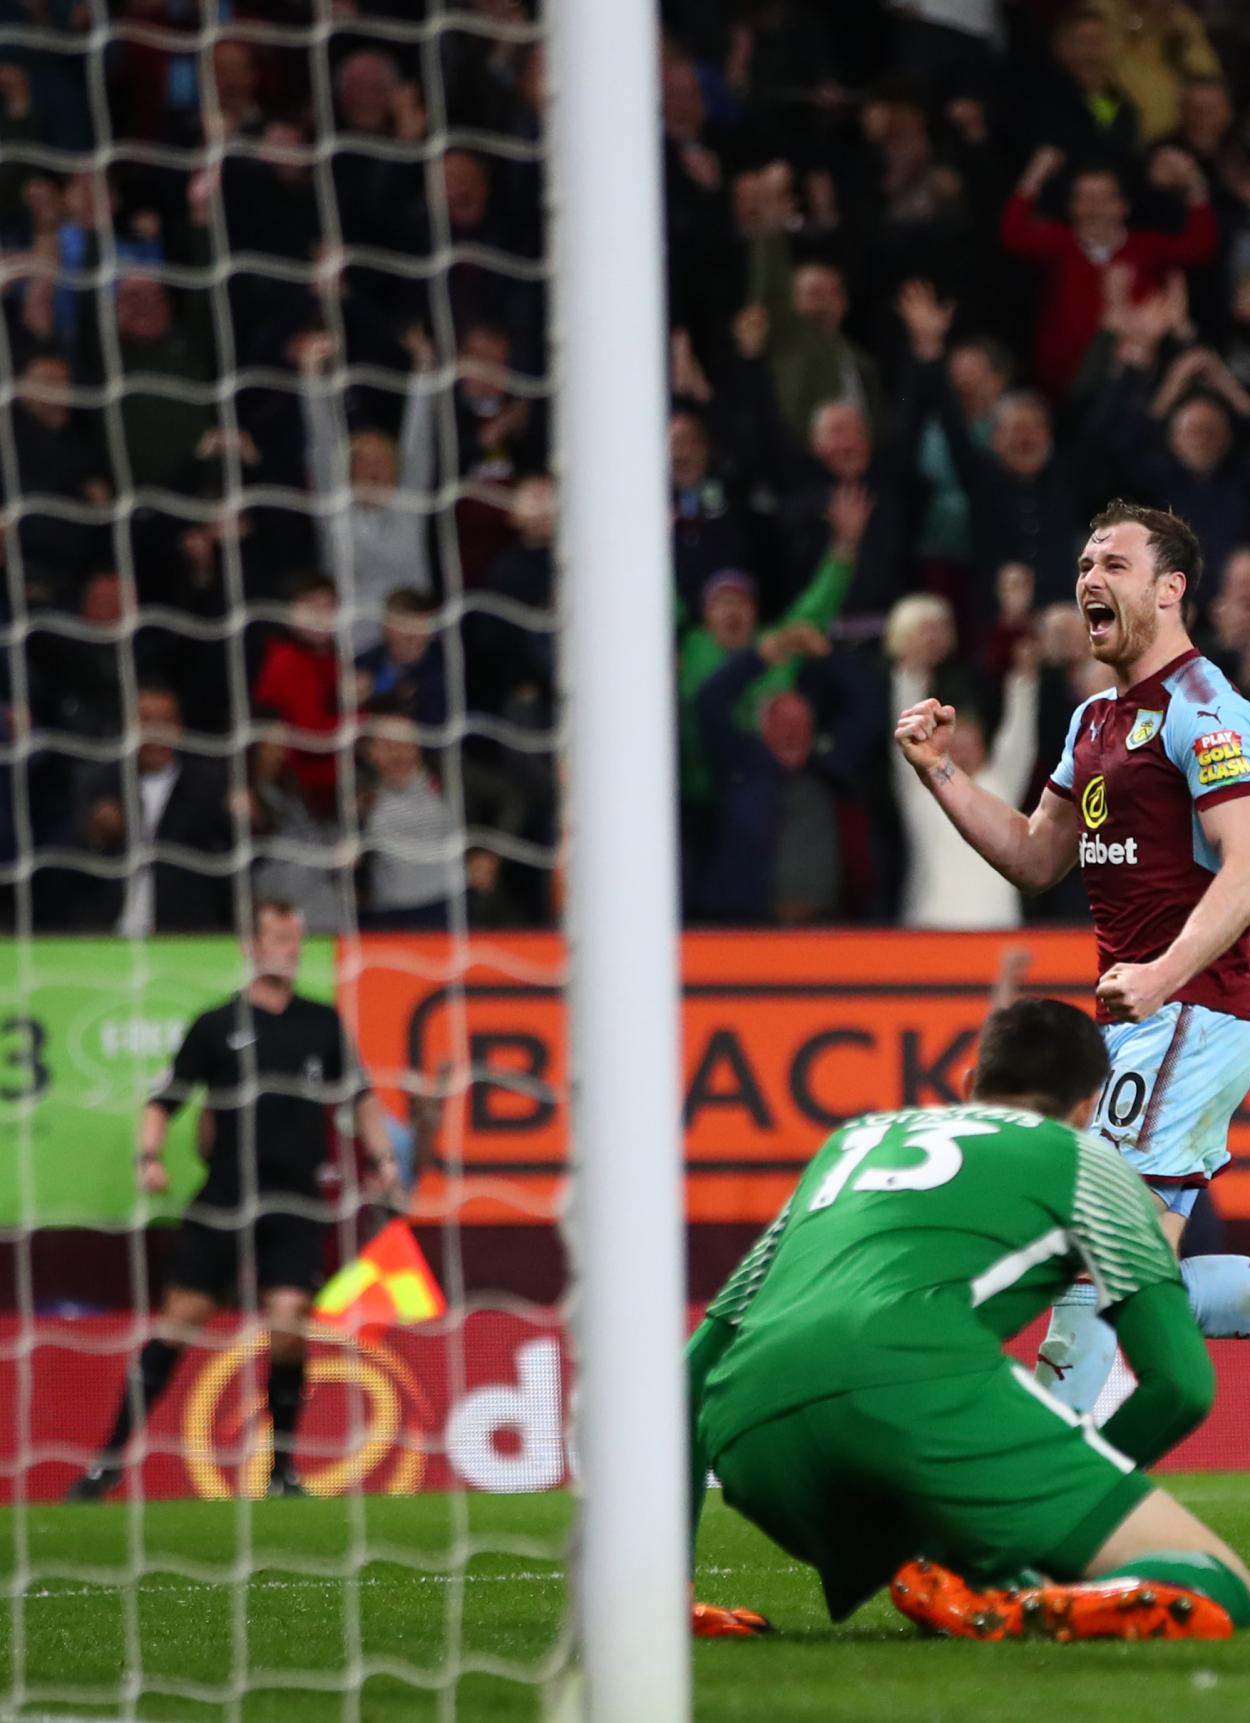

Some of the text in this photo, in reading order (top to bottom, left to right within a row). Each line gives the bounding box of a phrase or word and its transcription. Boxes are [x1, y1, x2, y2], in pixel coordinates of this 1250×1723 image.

[1199, 743, 1242, 766] GOLF
[1201, 731, 1233, 748] PLAY
[1079, 832, 1138, 868] fabet
[470, 1028, 985, 1135] BACK
[807, 1119, 1000, 1212] 13
